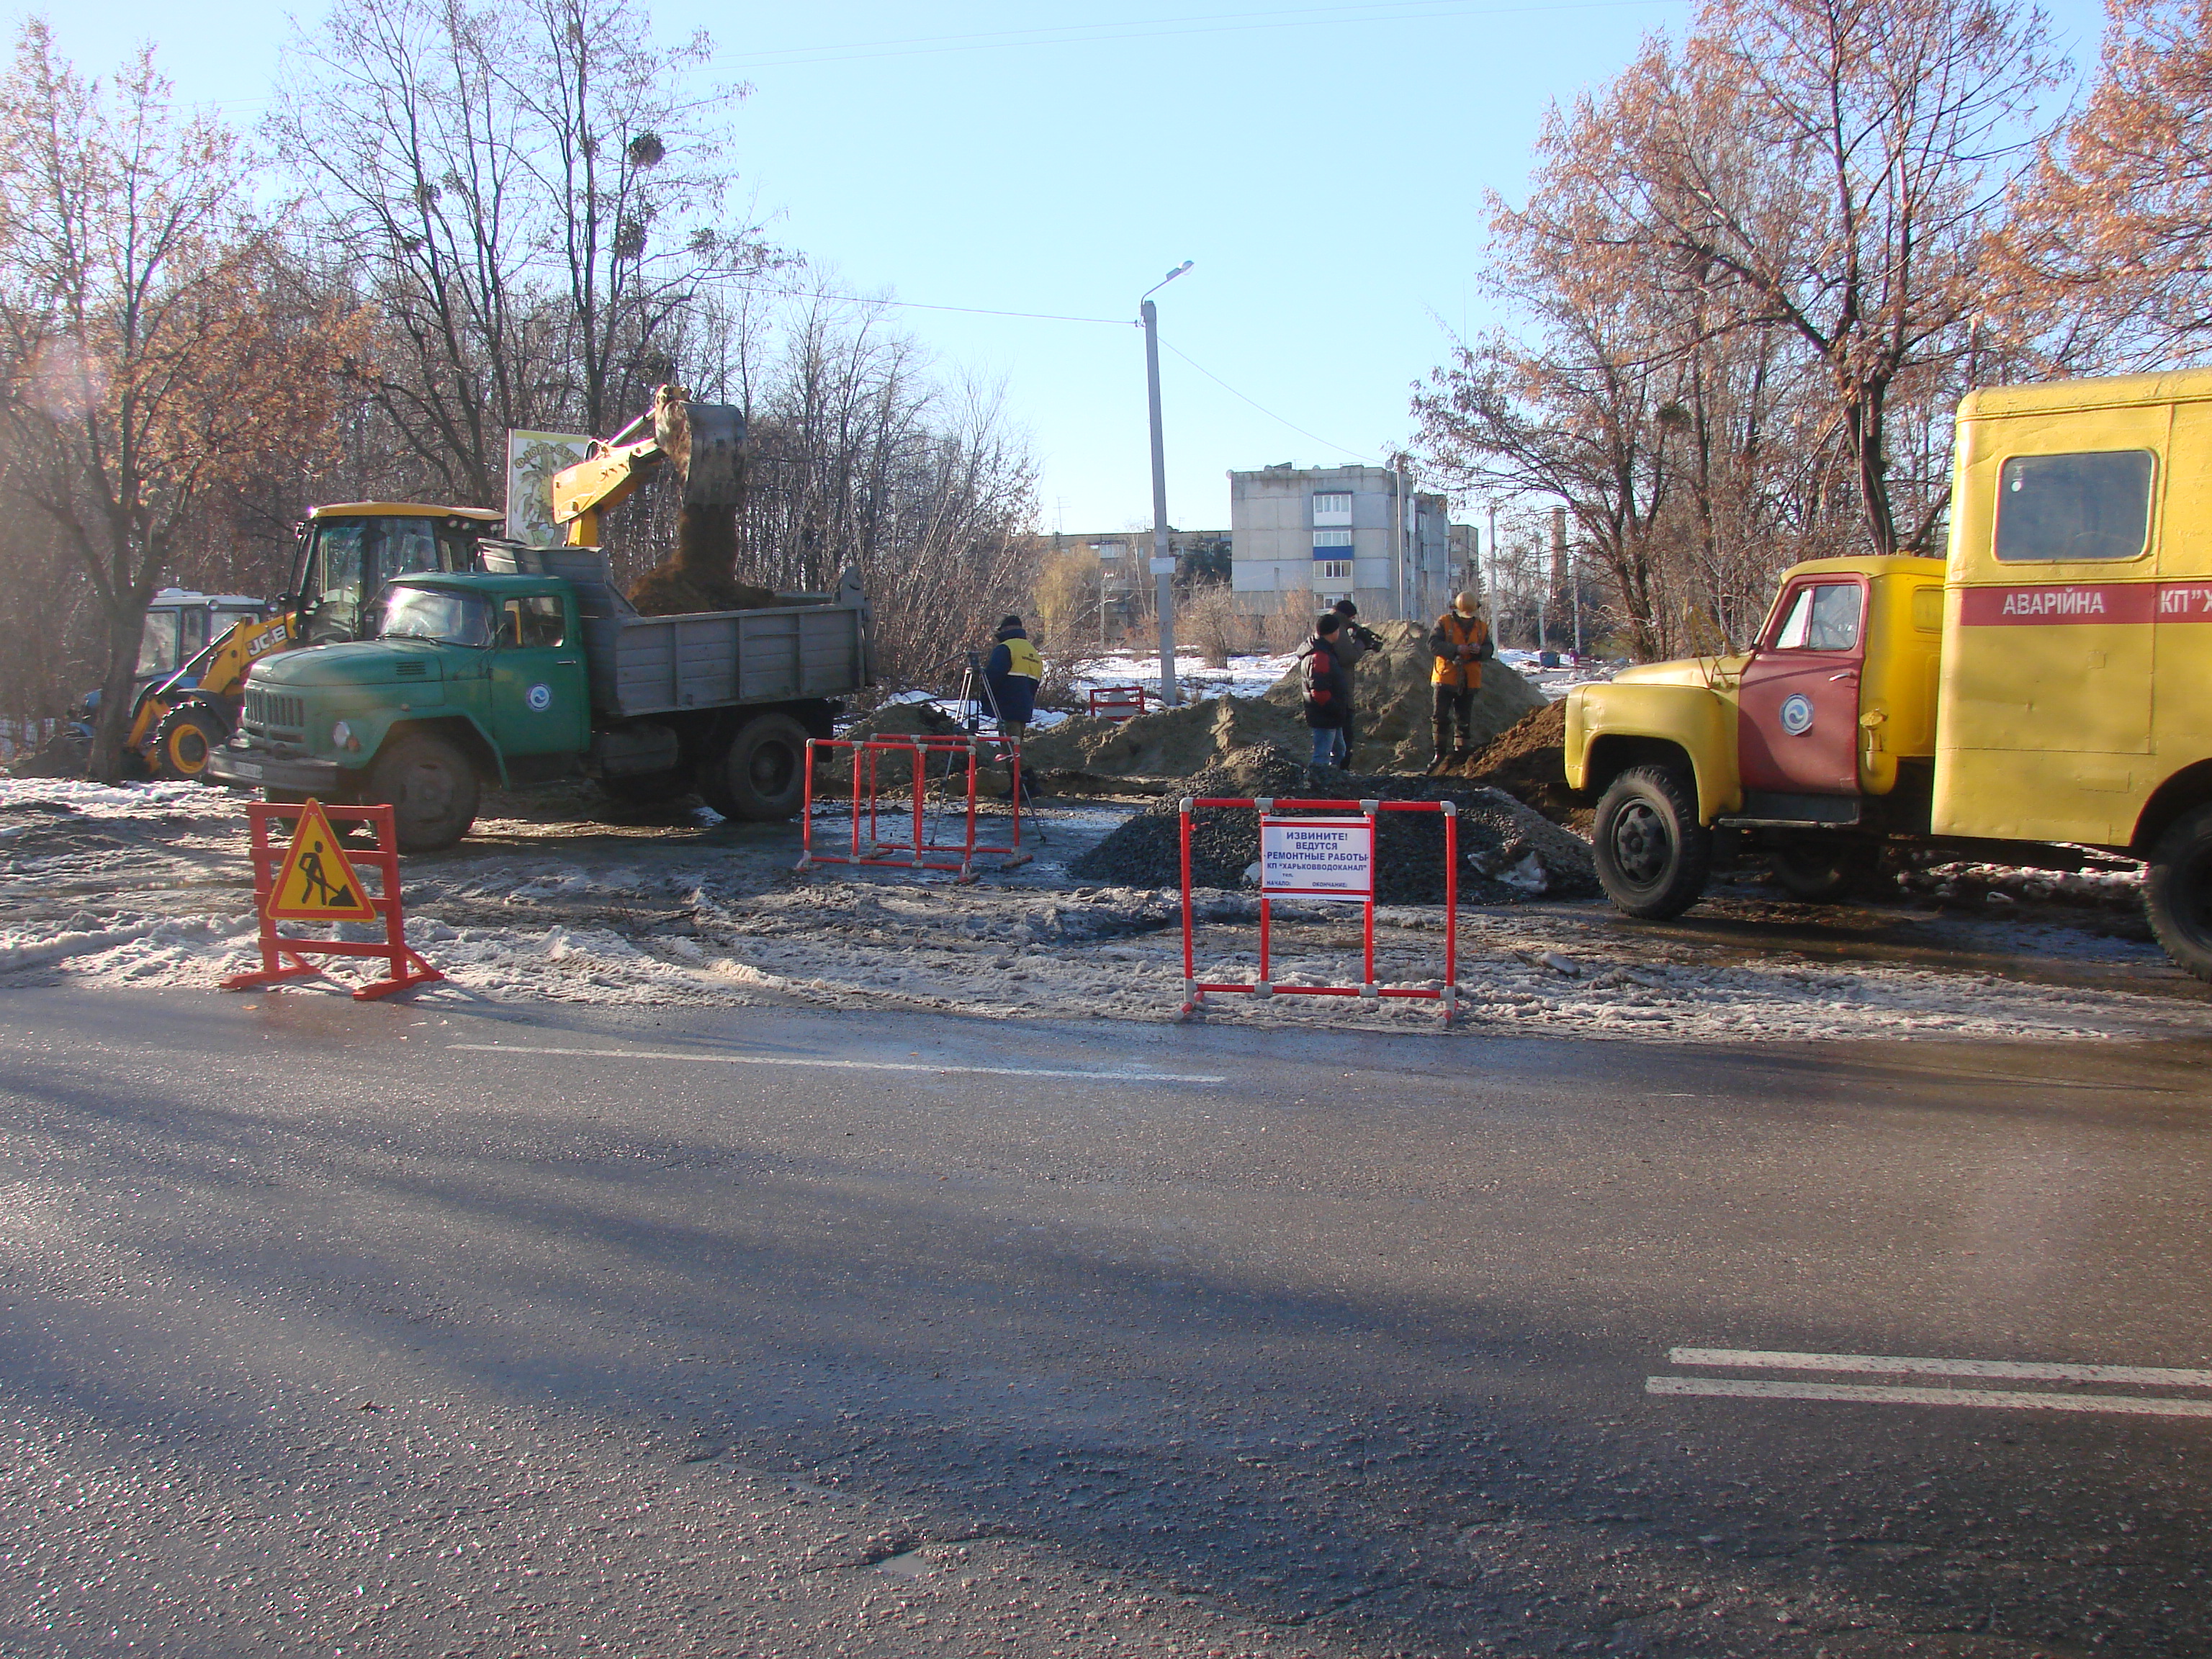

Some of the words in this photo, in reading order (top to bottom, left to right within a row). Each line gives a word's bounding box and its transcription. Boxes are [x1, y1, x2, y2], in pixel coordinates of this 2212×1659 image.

[515, 443, 583, 468] ФЛОРА-СЕРВ
[2002, 588, 2105, 615] АВАРІЙНА
[249, 624, 287, 656] JCB
[1286, 832, 1348, 841] ИЗВИНИТЕ!
[1295, 842, 1338, 851] ВЕДУТСЯ
[1267, 851, 1326, 860] РЕМОНТНЫЕ
[1328, 853, 1367, 861] РАБОТЫ
